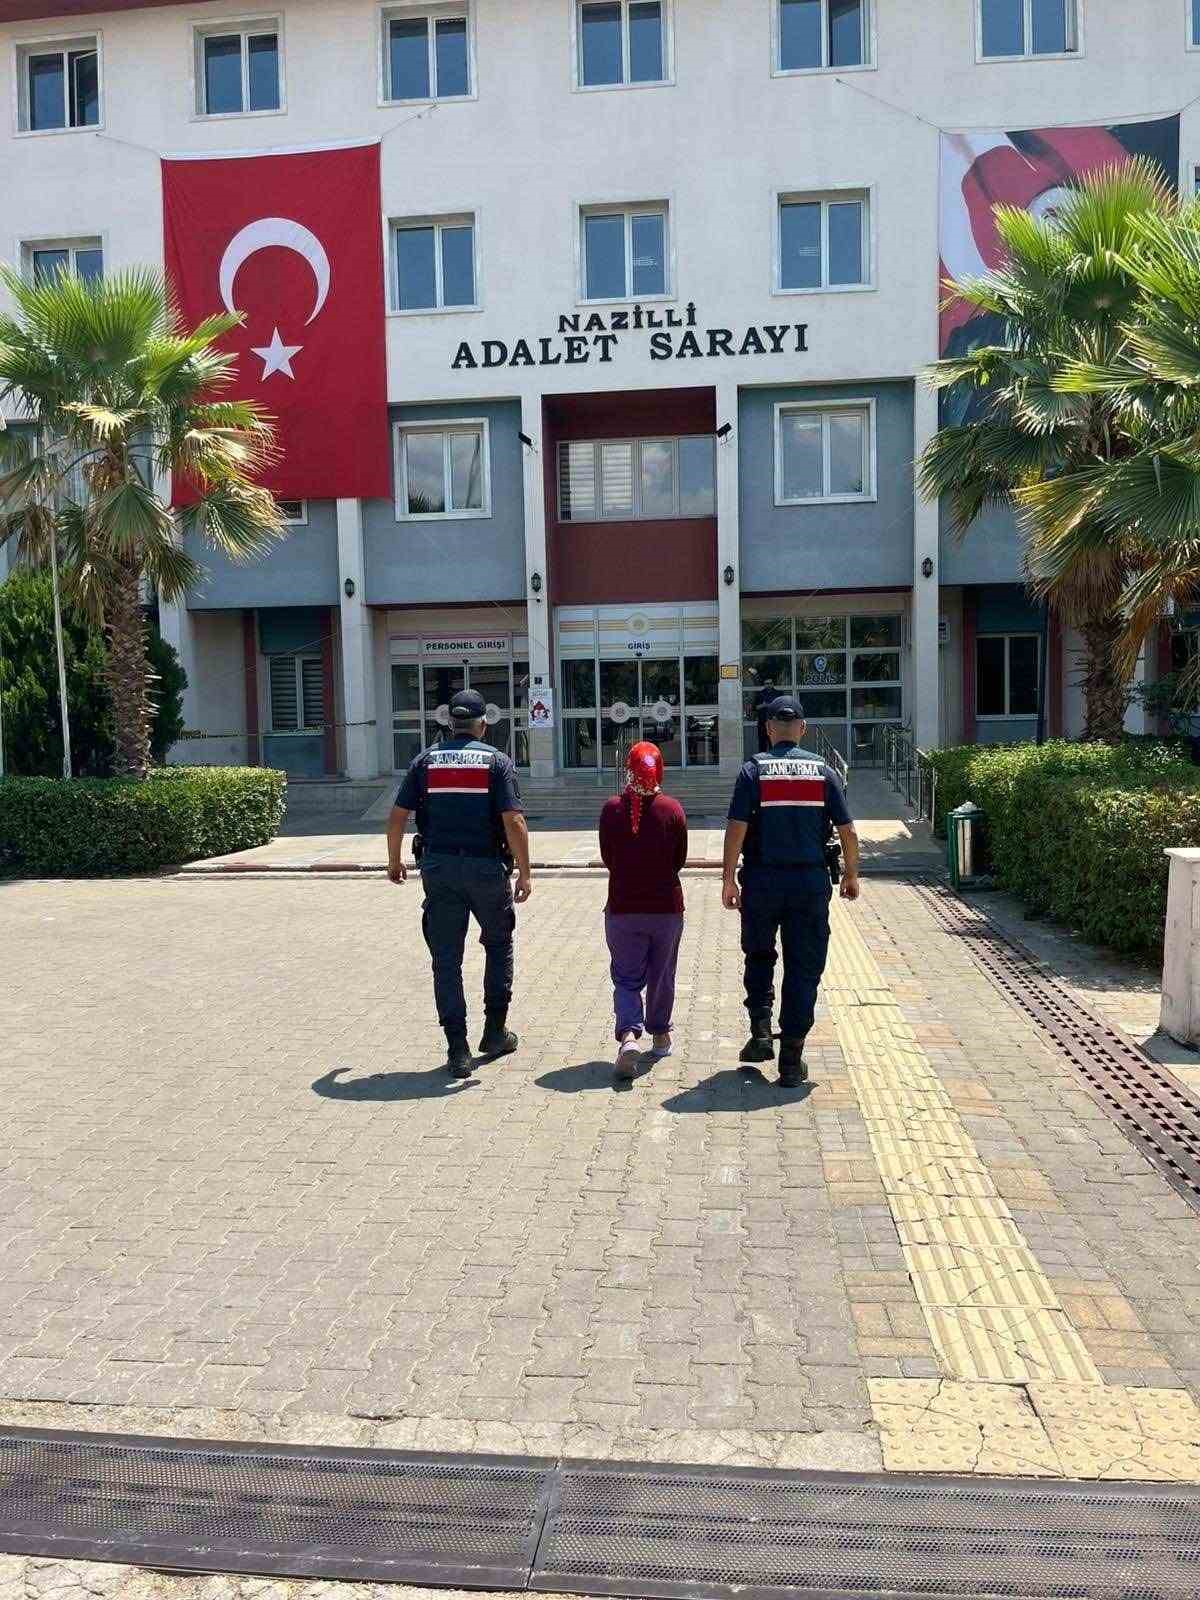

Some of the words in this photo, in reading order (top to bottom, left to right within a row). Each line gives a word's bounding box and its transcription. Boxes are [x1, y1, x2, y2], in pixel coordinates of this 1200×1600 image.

[558, 302, 696, 332] NAZİLLİ
[450, 334, 617, 369] ADALET
[649, 324, 808, 361] SARAYI
[425, 642, 474, 650] PERSONEL
[767, 762, 819, 776] JANDARMA
